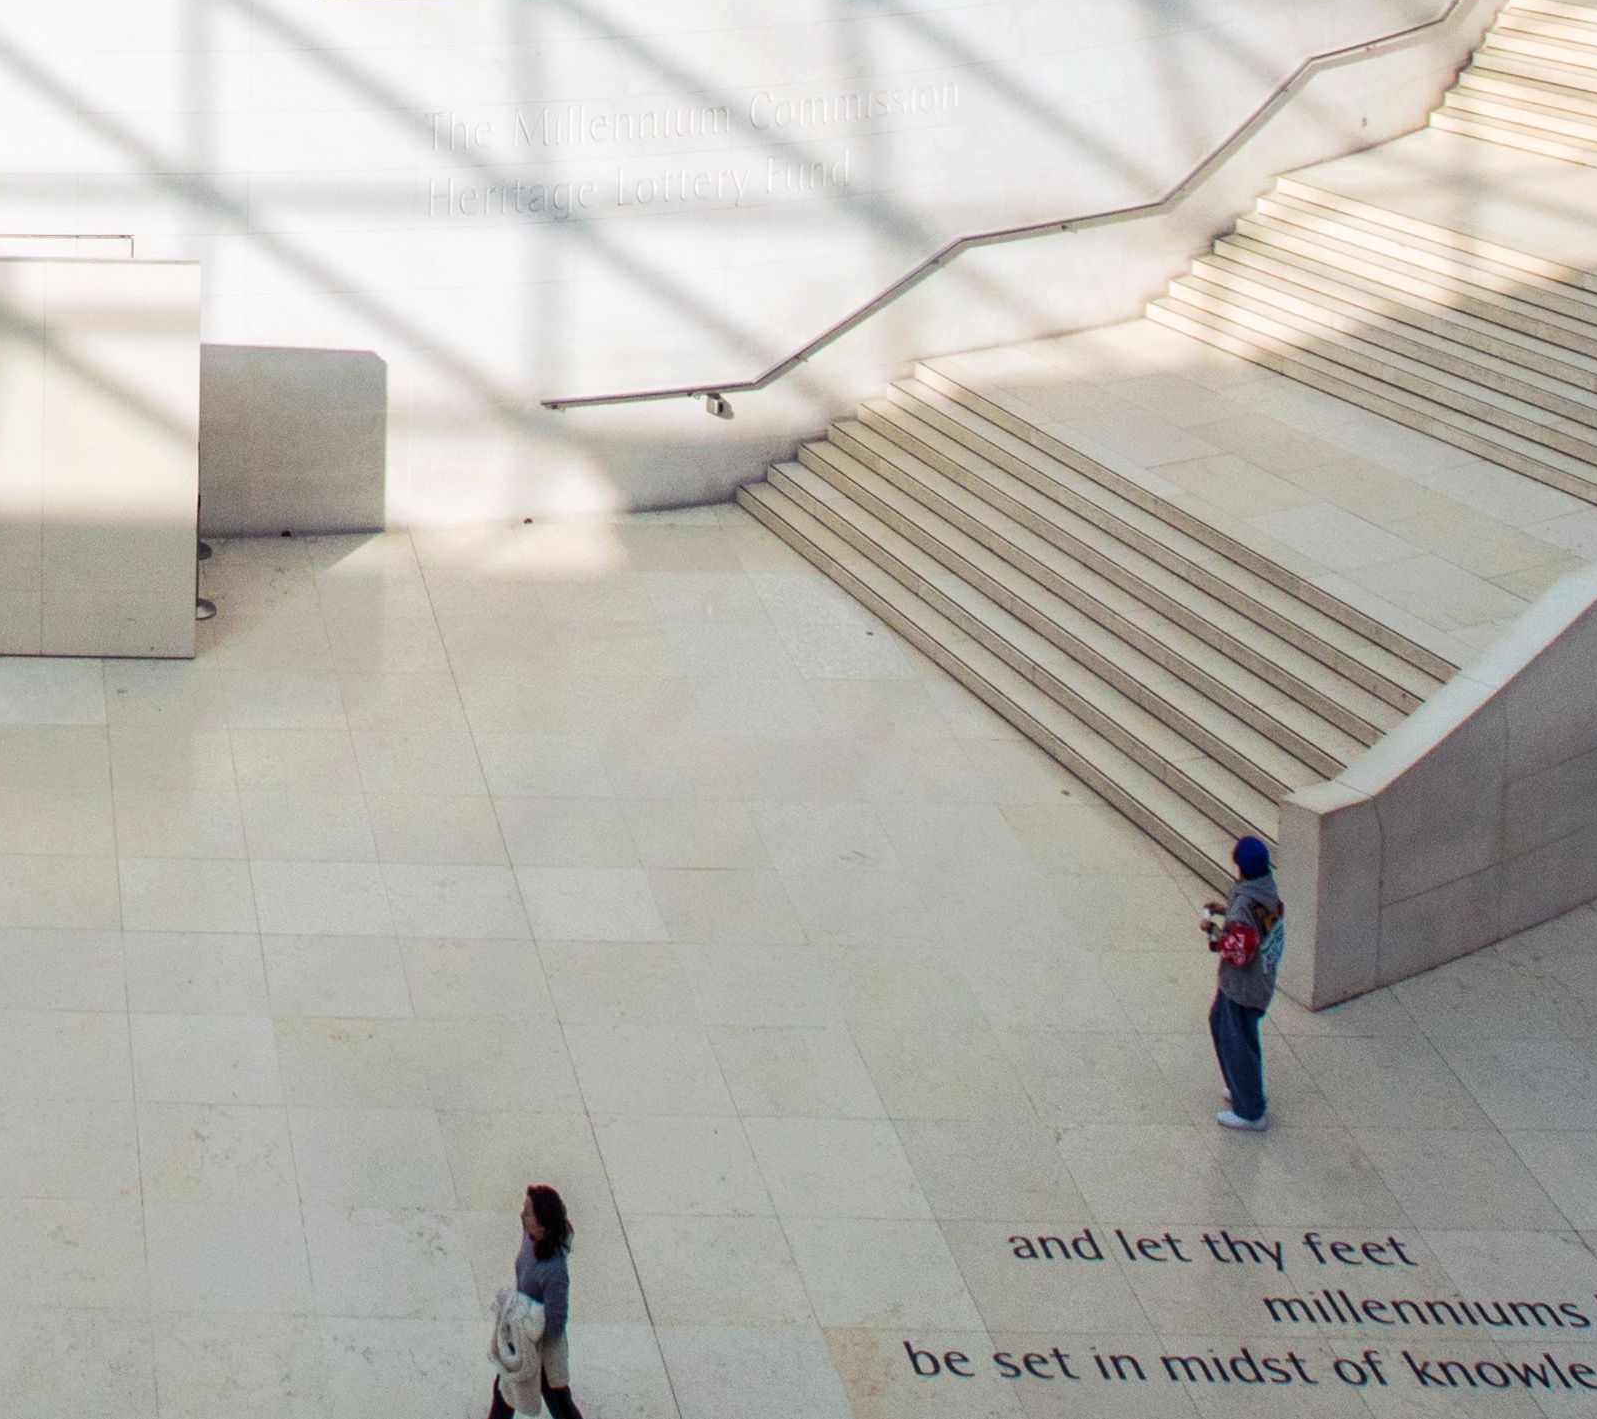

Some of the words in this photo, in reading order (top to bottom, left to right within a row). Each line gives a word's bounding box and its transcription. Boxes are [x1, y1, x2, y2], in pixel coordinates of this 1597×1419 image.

[424, 110, 495, 151] The
[511, 104, 733, 149] Millennium
[748, 82, 961, 132] Commission
[427, 177, 598, 222] Heritage
[615, 165, 750, 209] Lottery
[765, 149, 851, 195] Fund
[1008, 1228, 1105, 1262] and
[1115, 1228, 1193, 1262] let
[1201, 1230, 1286, 1273] thy
[1302, 1232, 1420, 1267] feet
[1263, 1289, 1591, 1329] millenniums
[903, 1339, 975, 1379] be
[992, 1347, 1081, 1381] set
[1089, 1346, 1147, 1382] in
[1160, 1347, 1320, 1385] midst
[1332, 1349, 1390, 1387] of
